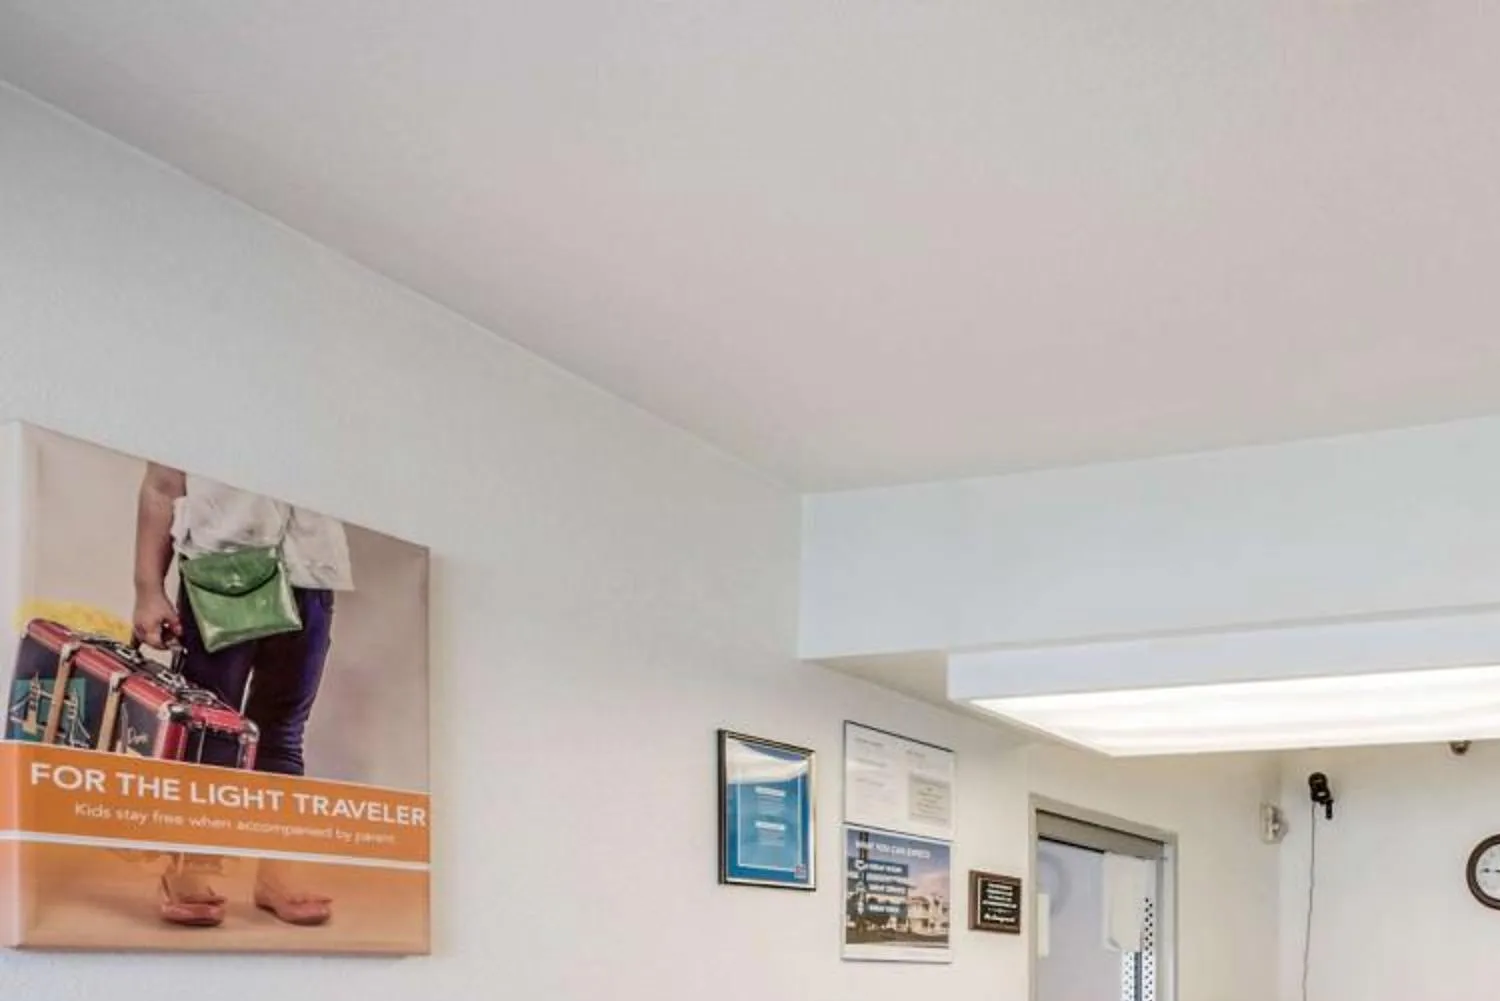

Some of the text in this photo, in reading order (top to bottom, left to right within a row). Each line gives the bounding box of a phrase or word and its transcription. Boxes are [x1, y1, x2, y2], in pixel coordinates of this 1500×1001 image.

[31, 762, 427, 827] FOR THE LIGHT TRAVELER
[75, 801, 111, 819] Kids
[116, 807, 148, 824] stay
[152, 809, 184, 826] free
[188, 815, 231, 829] when
[335, 828, 352, 844] by
